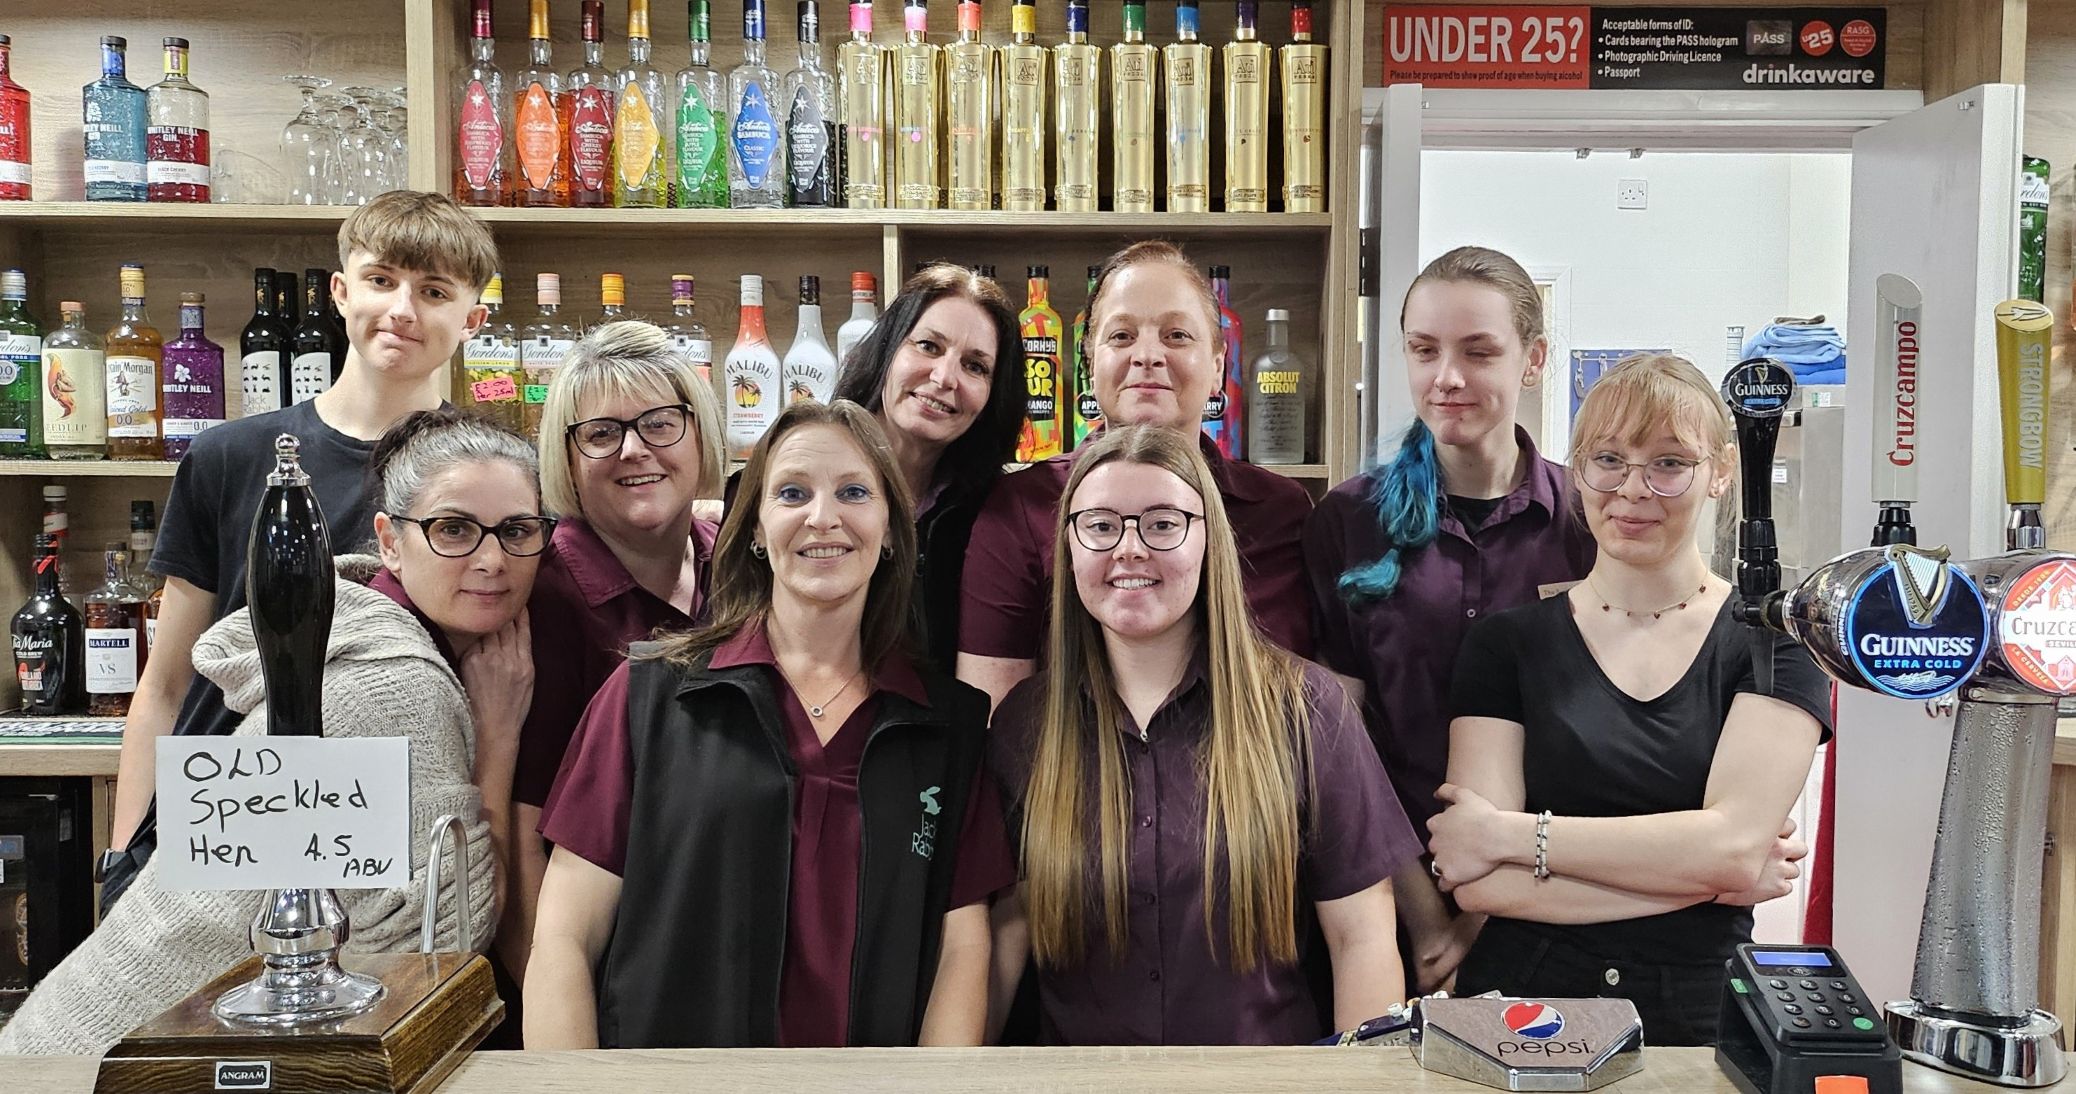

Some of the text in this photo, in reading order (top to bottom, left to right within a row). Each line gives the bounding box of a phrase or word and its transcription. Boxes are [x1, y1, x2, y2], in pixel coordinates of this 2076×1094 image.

[1602, 19, 1694, 32] Acceptable forms of ID:
[1846, 26, 1870, 35] RASG
[1390, 16, 1584, 63] UNDER 25?
[1605, 34, 1739, 48] Cards bearing the PASS hologram
[1753, 32, 1785, 44] PASS
[1604, 50, 1722, 64] Photographic Driving Licence
[1390, 70, 1412, 80] Please
[1413, 70, 1422, 80] be
[1422, 70, 1453, 81] prepared
[1454, 71, 1460, 80] to
[1461, 71, 1478, 80] show
[1479, 71, 1496, 81] proof
[1497, 71, 1503, 80] of
[1504, 72, 1517, 81] age
[1535, 71, 1557, 81] buying
[1558, 71, 1582, 80] alcohol
[1604, 66, 1640, 79] Passport
[1743, 63, 1875, 84] drinkaware
[177, 126, 199, 137] NEILL
[466, 342, 514, 360] Gordon's
[523, 342, 565, 359] Gordon
[124, 361, 153, 375] Morgan
[726, 359, 774, 380] MALIBU
[1024, 358, 1051, 378] SO
[1256, 371, 1300, 384] ABSOLUT
[190, 384, 212, 393] NEILL
[1027, 376, 1053, 397] UR
[1260, 383, 1297, 394] CITRON
[1735, 383, 1788, 397] GUINNESS
[1886, 321, 1919, 467] Cruzcampo
[1081, 400, 1101, 410] APPL
[2019, 343, 2043, 471] STRONGBOW
[116, 415, 133, 425] 0.0
[2012, 615, 2076, 636] Cruzca
[21, 634, 53, 650] Maria
[1861, 633, 1975, 657] GUINNESS
[99, 663, 116, 675] VS
[1874, 659, 1963, 669] EXTRA COLD
[183, 748, 282, 783] OLD
[189, 779, 369, 833] Speckled
[919, 813, 937, 839] Jac
[189, 834, 259, 867] Hen
[221, 1071, 265, 1080] ANGRAM
